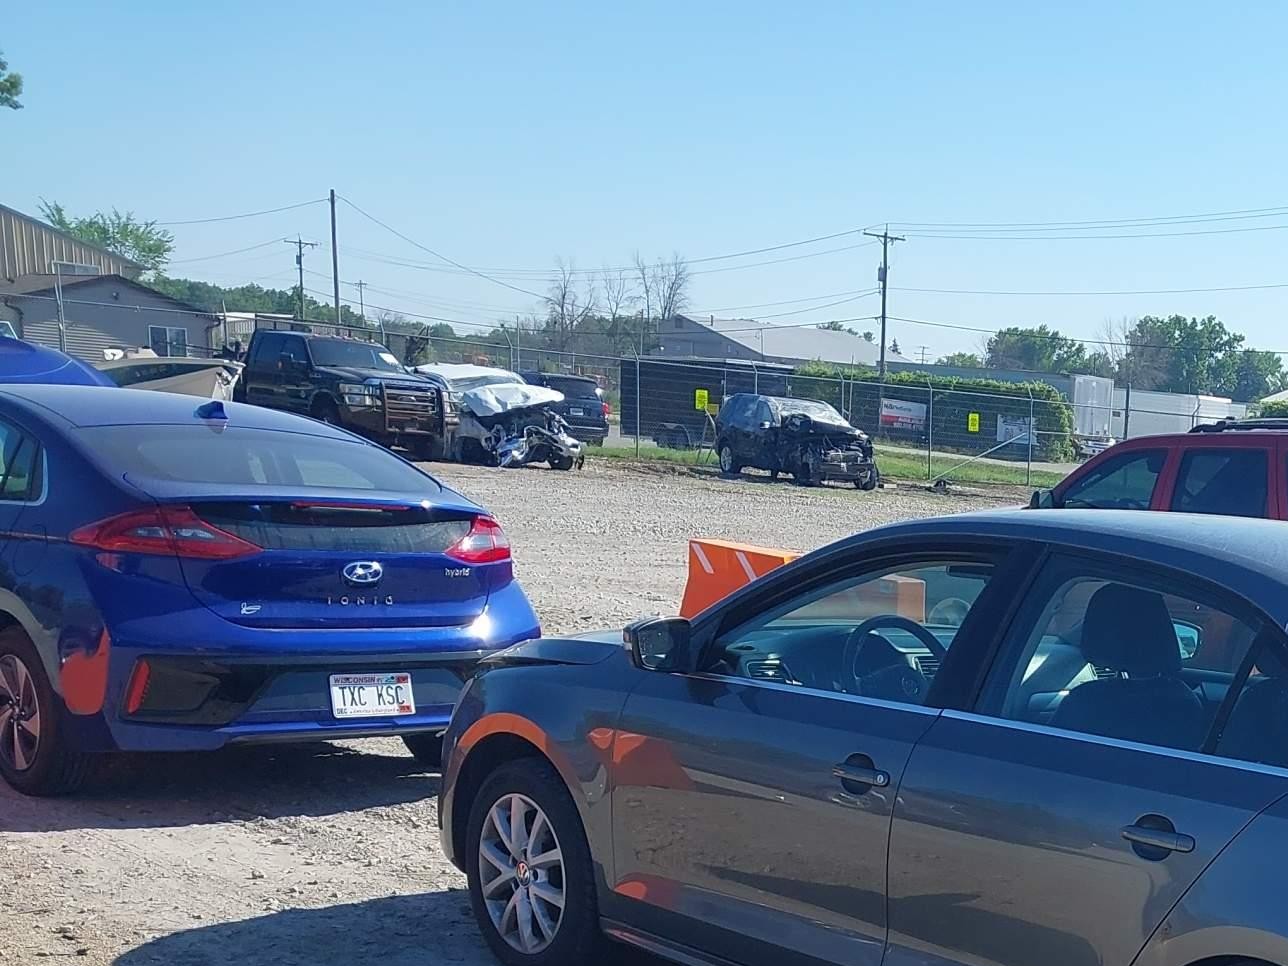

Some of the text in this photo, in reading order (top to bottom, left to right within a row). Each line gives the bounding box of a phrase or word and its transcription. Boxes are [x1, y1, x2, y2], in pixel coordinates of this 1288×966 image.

[445, 567, 471, 578] hybrid
[327, 595, 393, 606] IONIQ
[334, 676, 376, 684] WISCONSIN
[339, 685, 405, 707] TXC KSC
